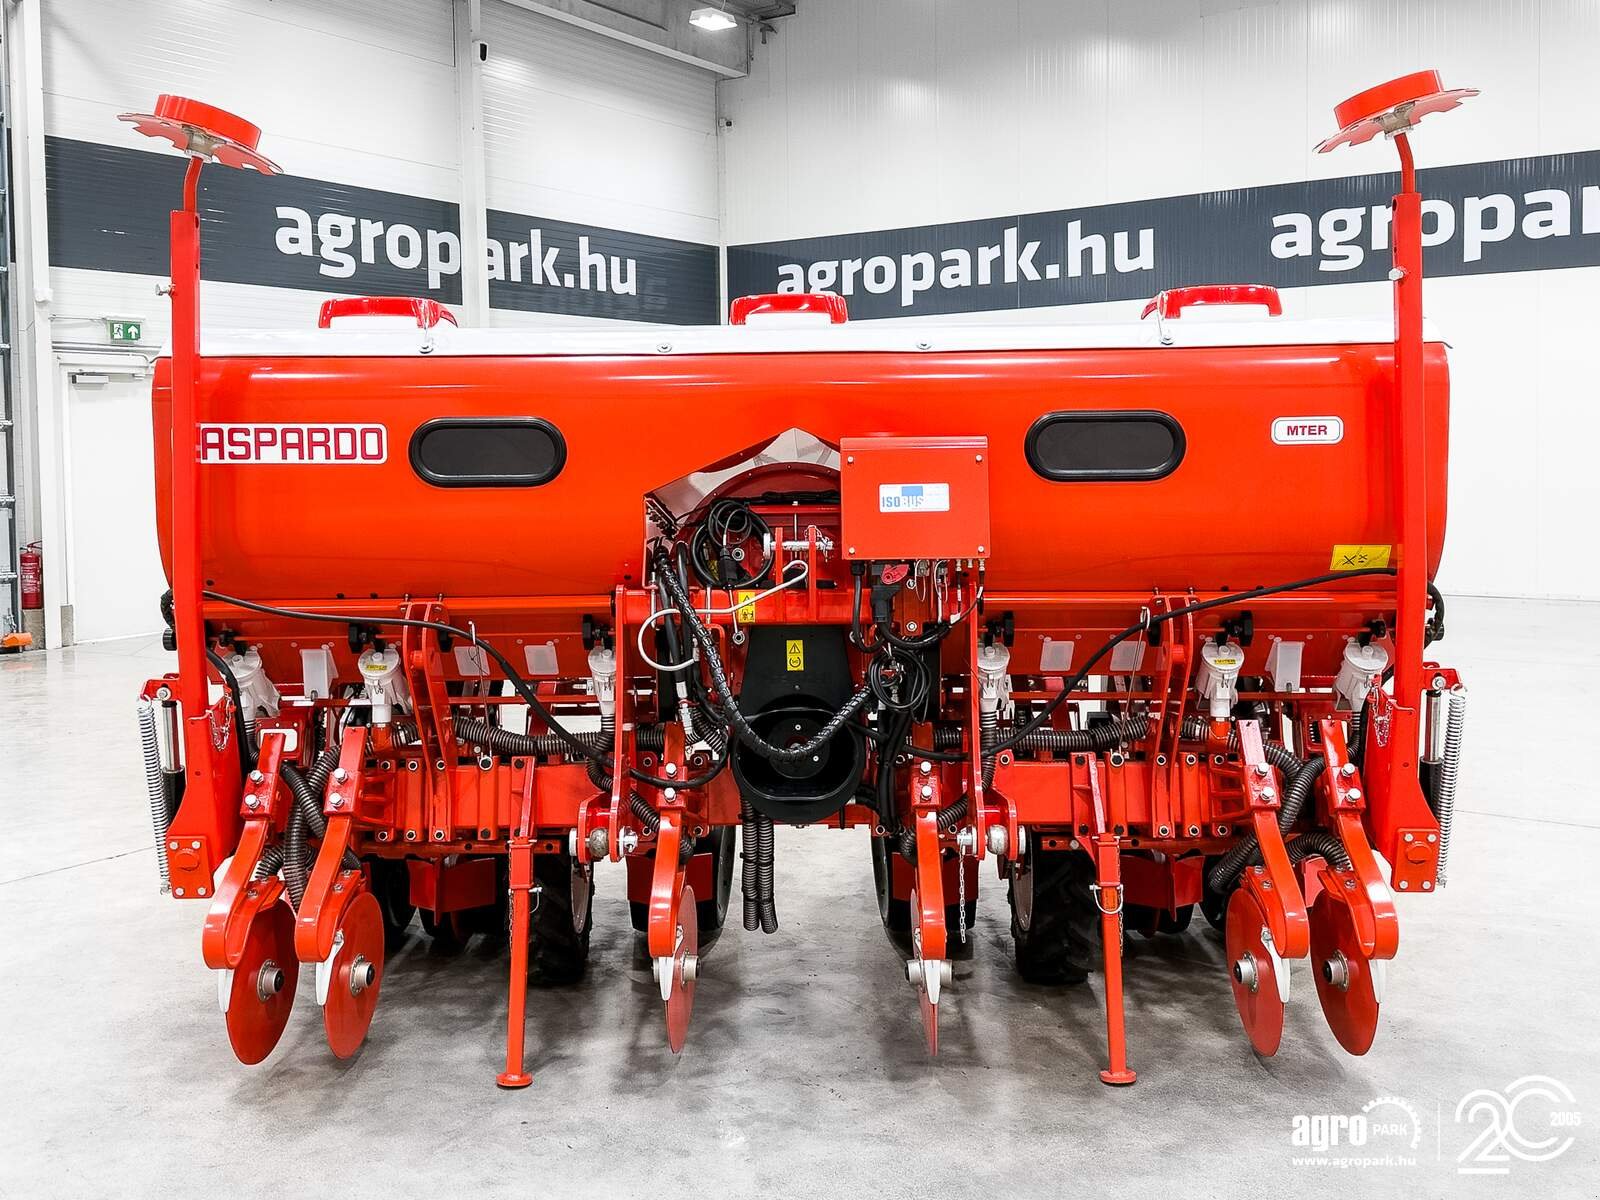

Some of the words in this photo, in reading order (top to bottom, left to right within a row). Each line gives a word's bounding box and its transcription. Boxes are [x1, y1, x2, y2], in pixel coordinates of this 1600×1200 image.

[776, 219, 1155, 307] agropark.hu
[196, 428, 384, 461] ASPARDO
[1286, 425, 1328, 436] MTER
